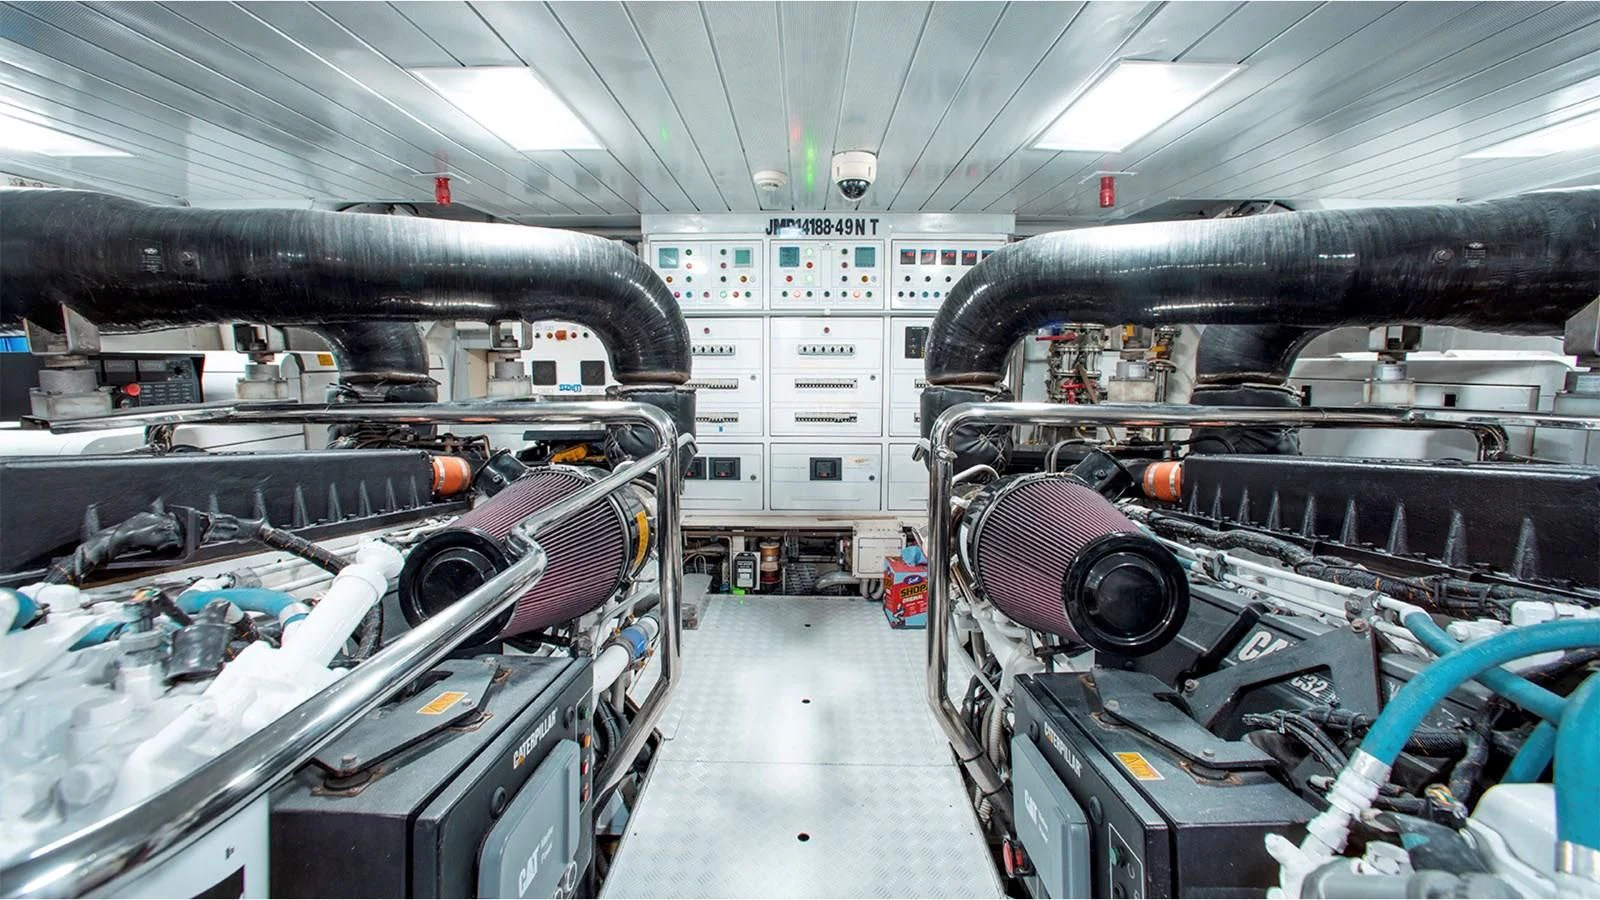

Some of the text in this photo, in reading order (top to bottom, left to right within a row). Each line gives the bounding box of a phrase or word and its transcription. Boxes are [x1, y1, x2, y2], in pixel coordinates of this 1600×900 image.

[1238, 630, 1297, 661] CA
[513, 707, 558, 769] CATERPILLAR
[518, 843, 540, 899] CAT
